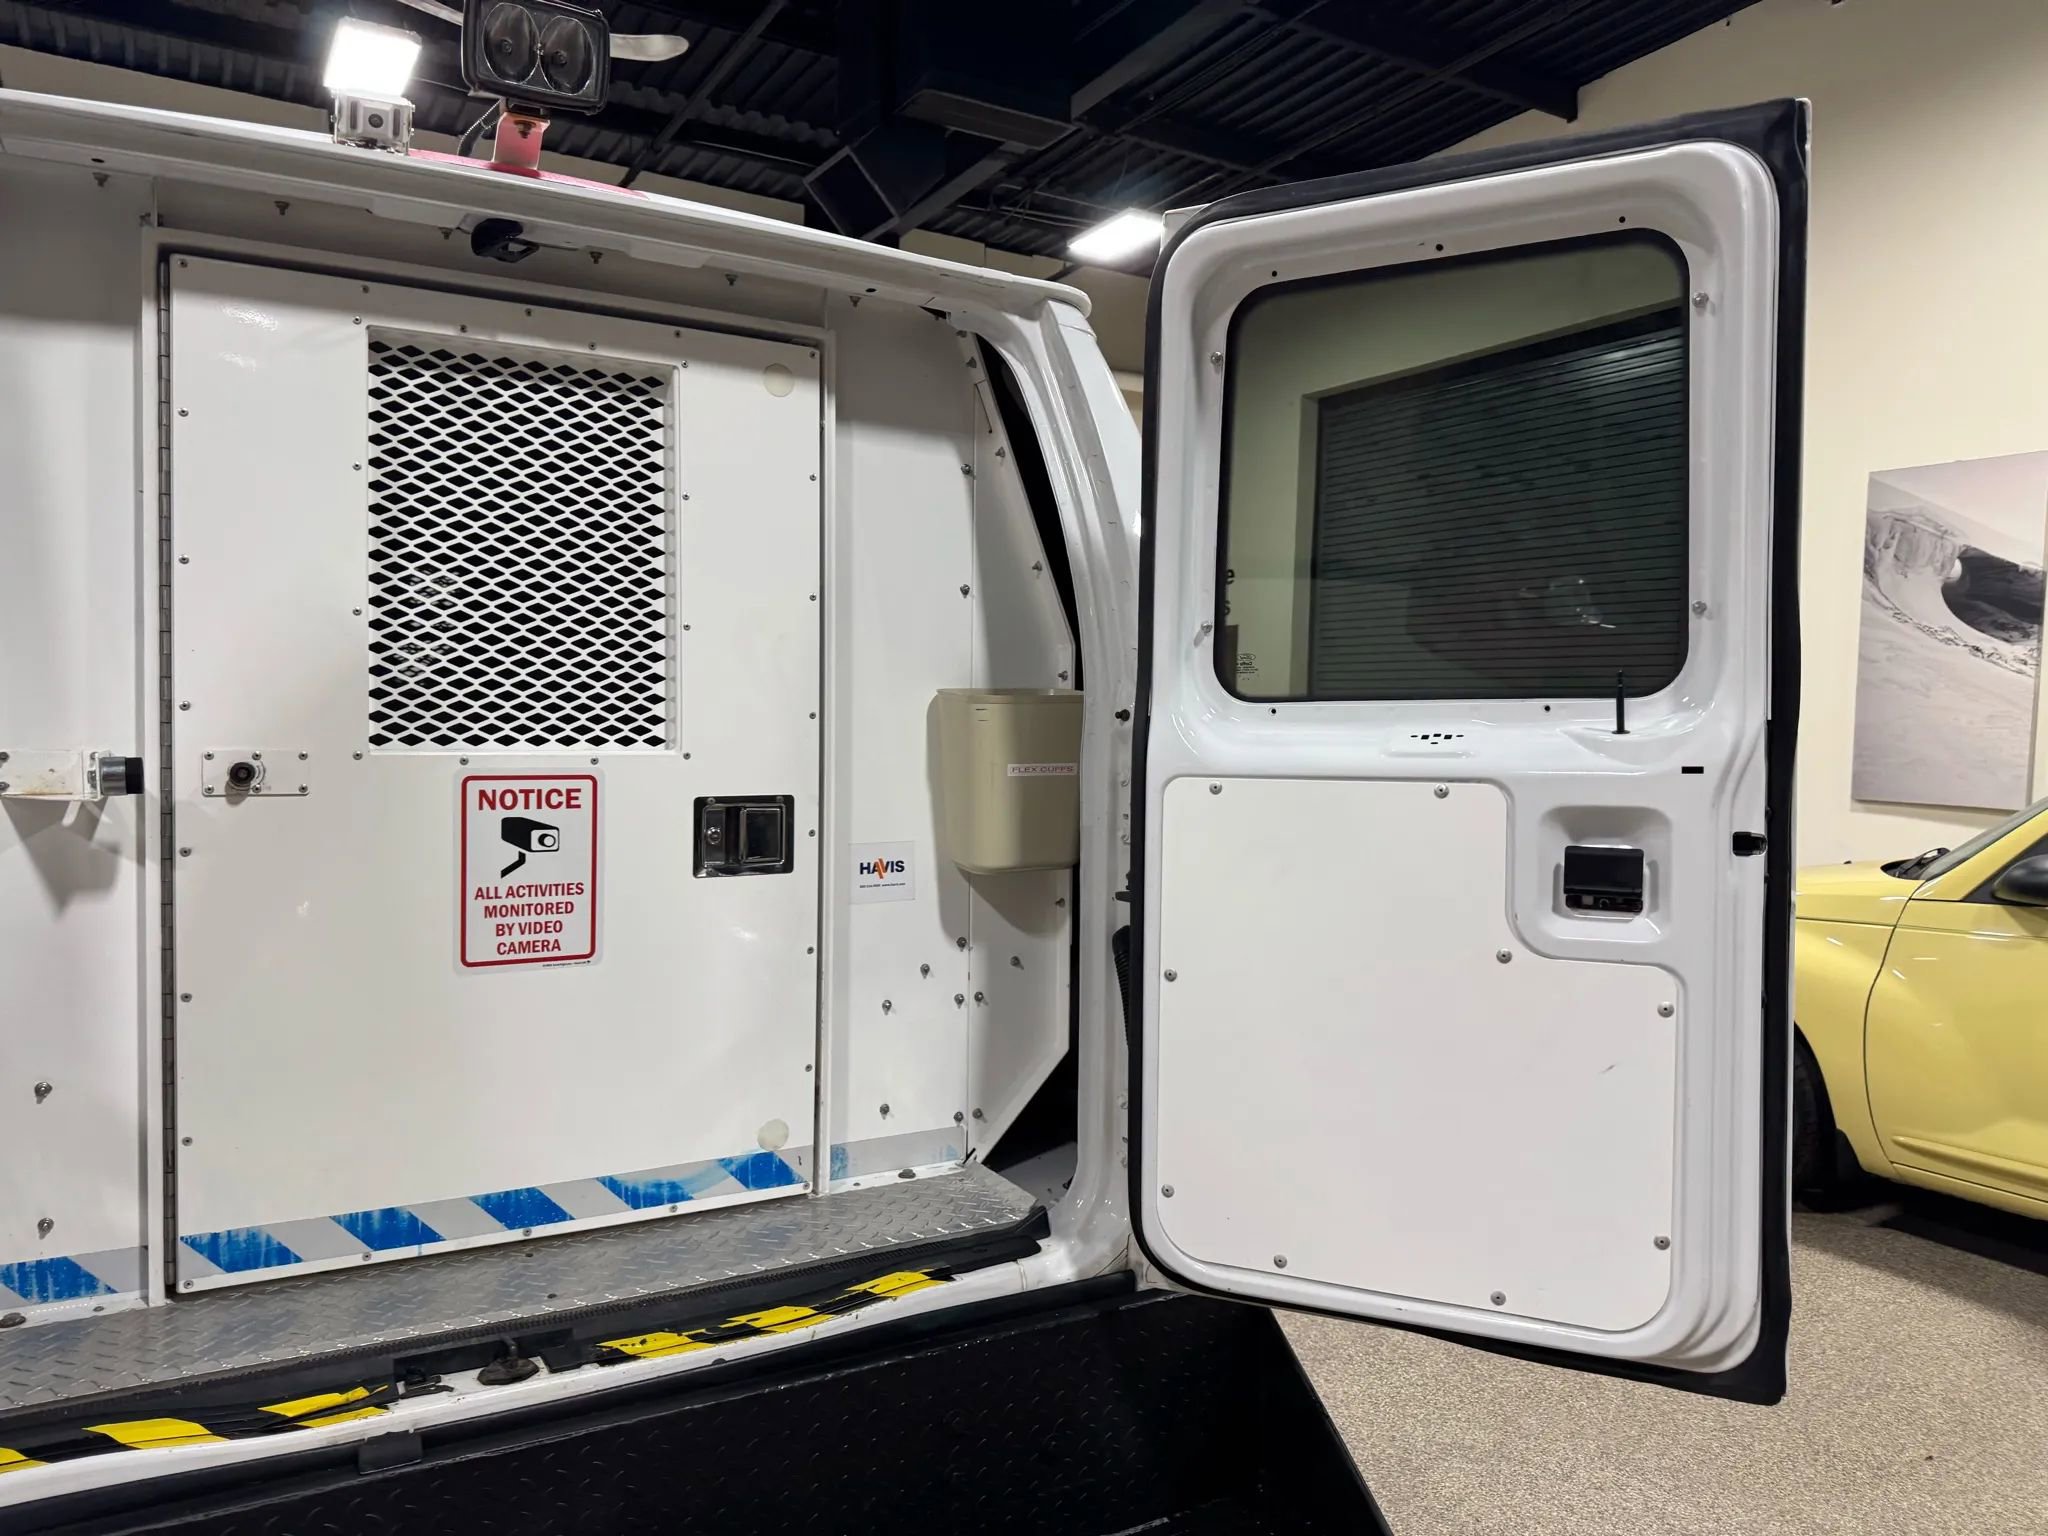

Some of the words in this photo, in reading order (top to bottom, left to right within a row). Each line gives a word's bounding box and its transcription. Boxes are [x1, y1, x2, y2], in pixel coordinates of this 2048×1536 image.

[478, 788, 582, 811] NOTICE
[859, 858, 905, 879] HAVIS
[474, 885, 502, 900] ALL
[505, 882, 585, 899] ACTIVITIES
[484, 901, 575, 919] MONITORED
[496, 923, 516, 937] BY
[518, 919, 563, 936] VIDEO
[496, 938, 561, 955] CAMERA
